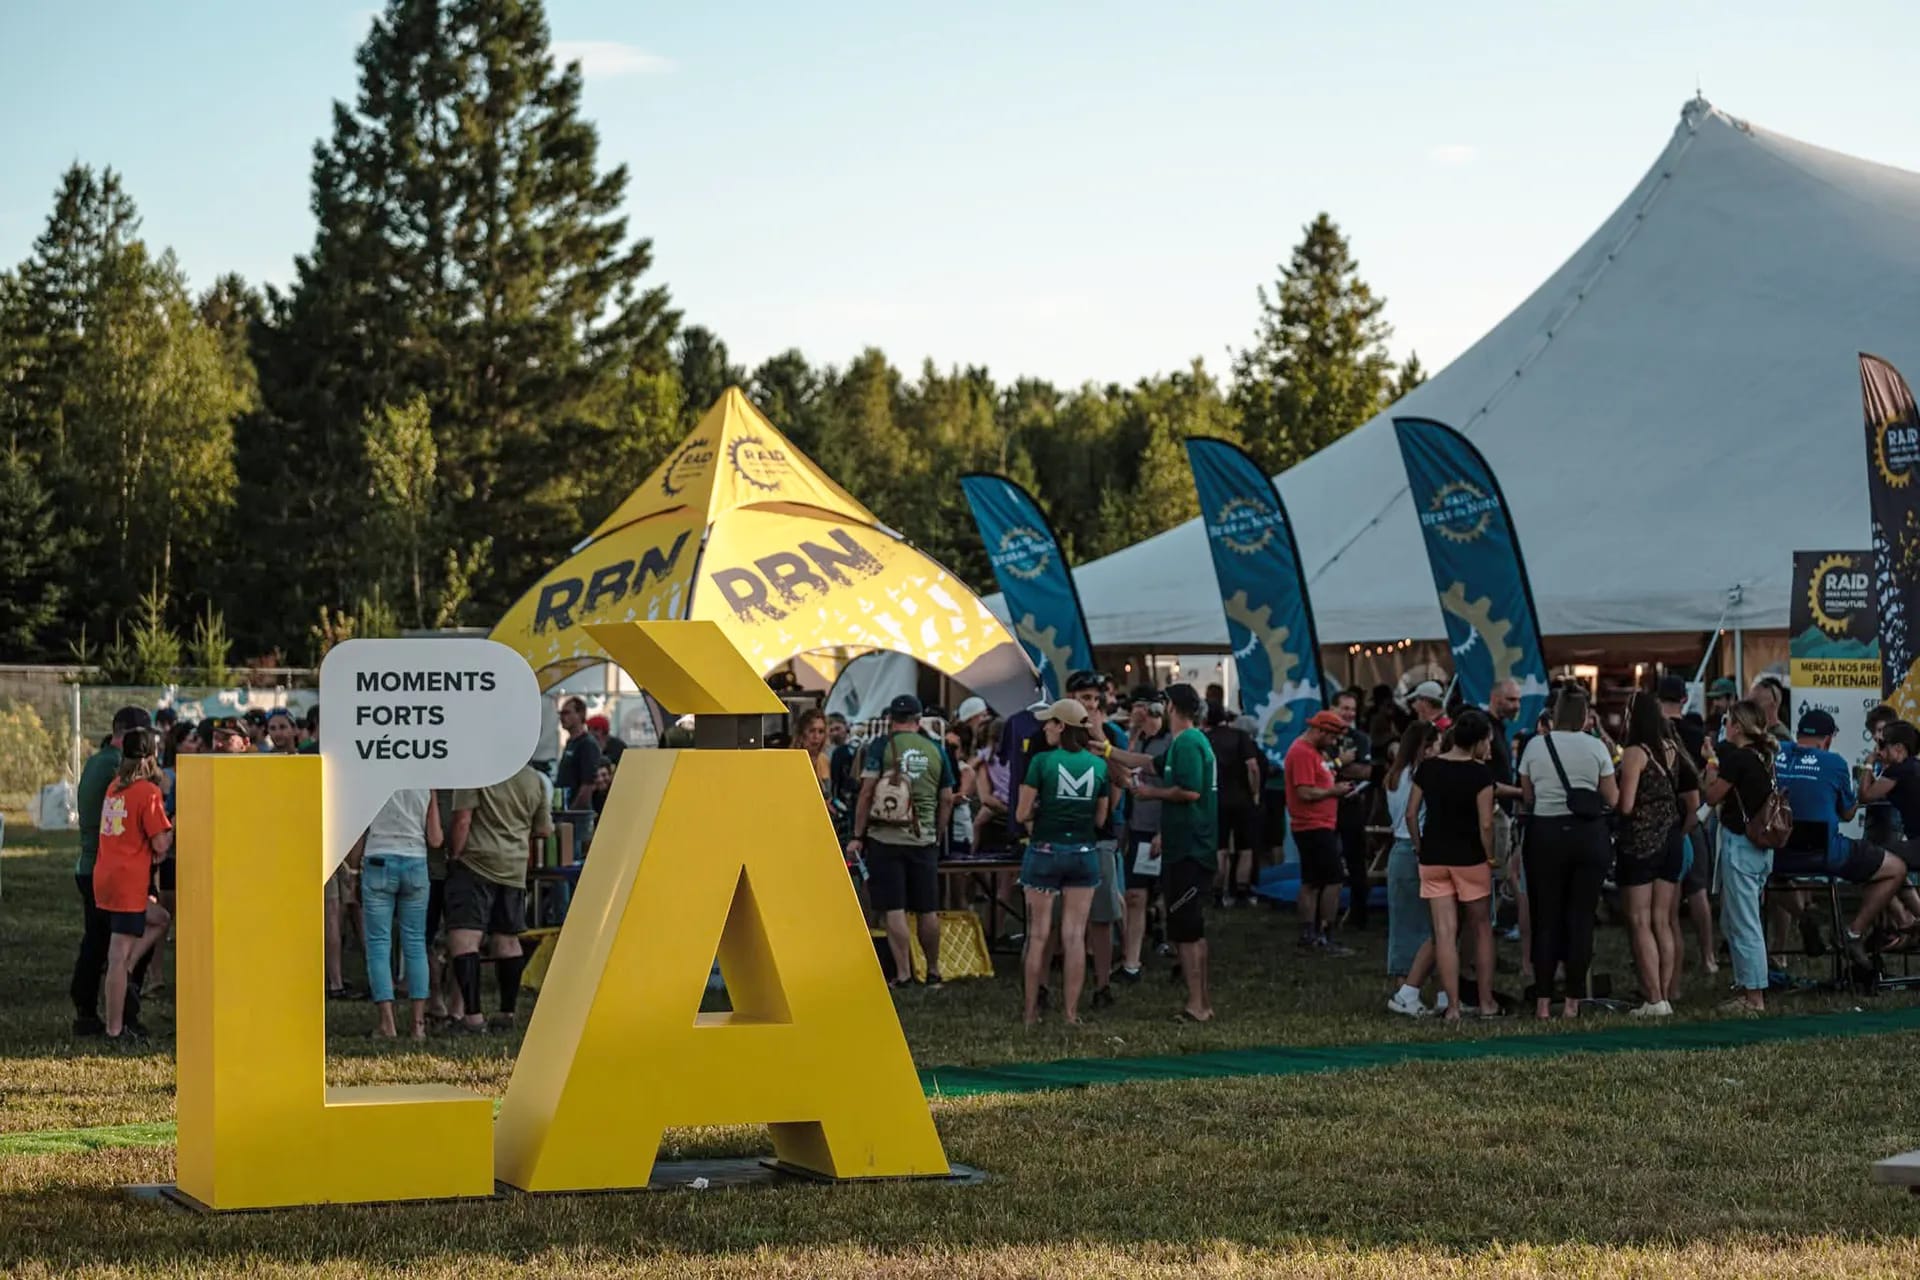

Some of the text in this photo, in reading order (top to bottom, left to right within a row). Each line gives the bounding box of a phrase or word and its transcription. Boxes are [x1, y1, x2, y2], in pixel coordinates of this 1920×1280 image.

[534, 529, 692, 635] RBN
[1825, 573, 1869, 590] RAID
[1801, 662, 1828, 672] MERCI
[1838, 662, 1858, 672] NOS
[1860, 662, 1881, 672] PRÉ
[356, 671, 496, 692] MOMENTS
[1813, 674, 1881, 687] PARTENAIR
[356, 705, 445, 726] FORTS
[355, 734, 449, 760] VÉCUS
